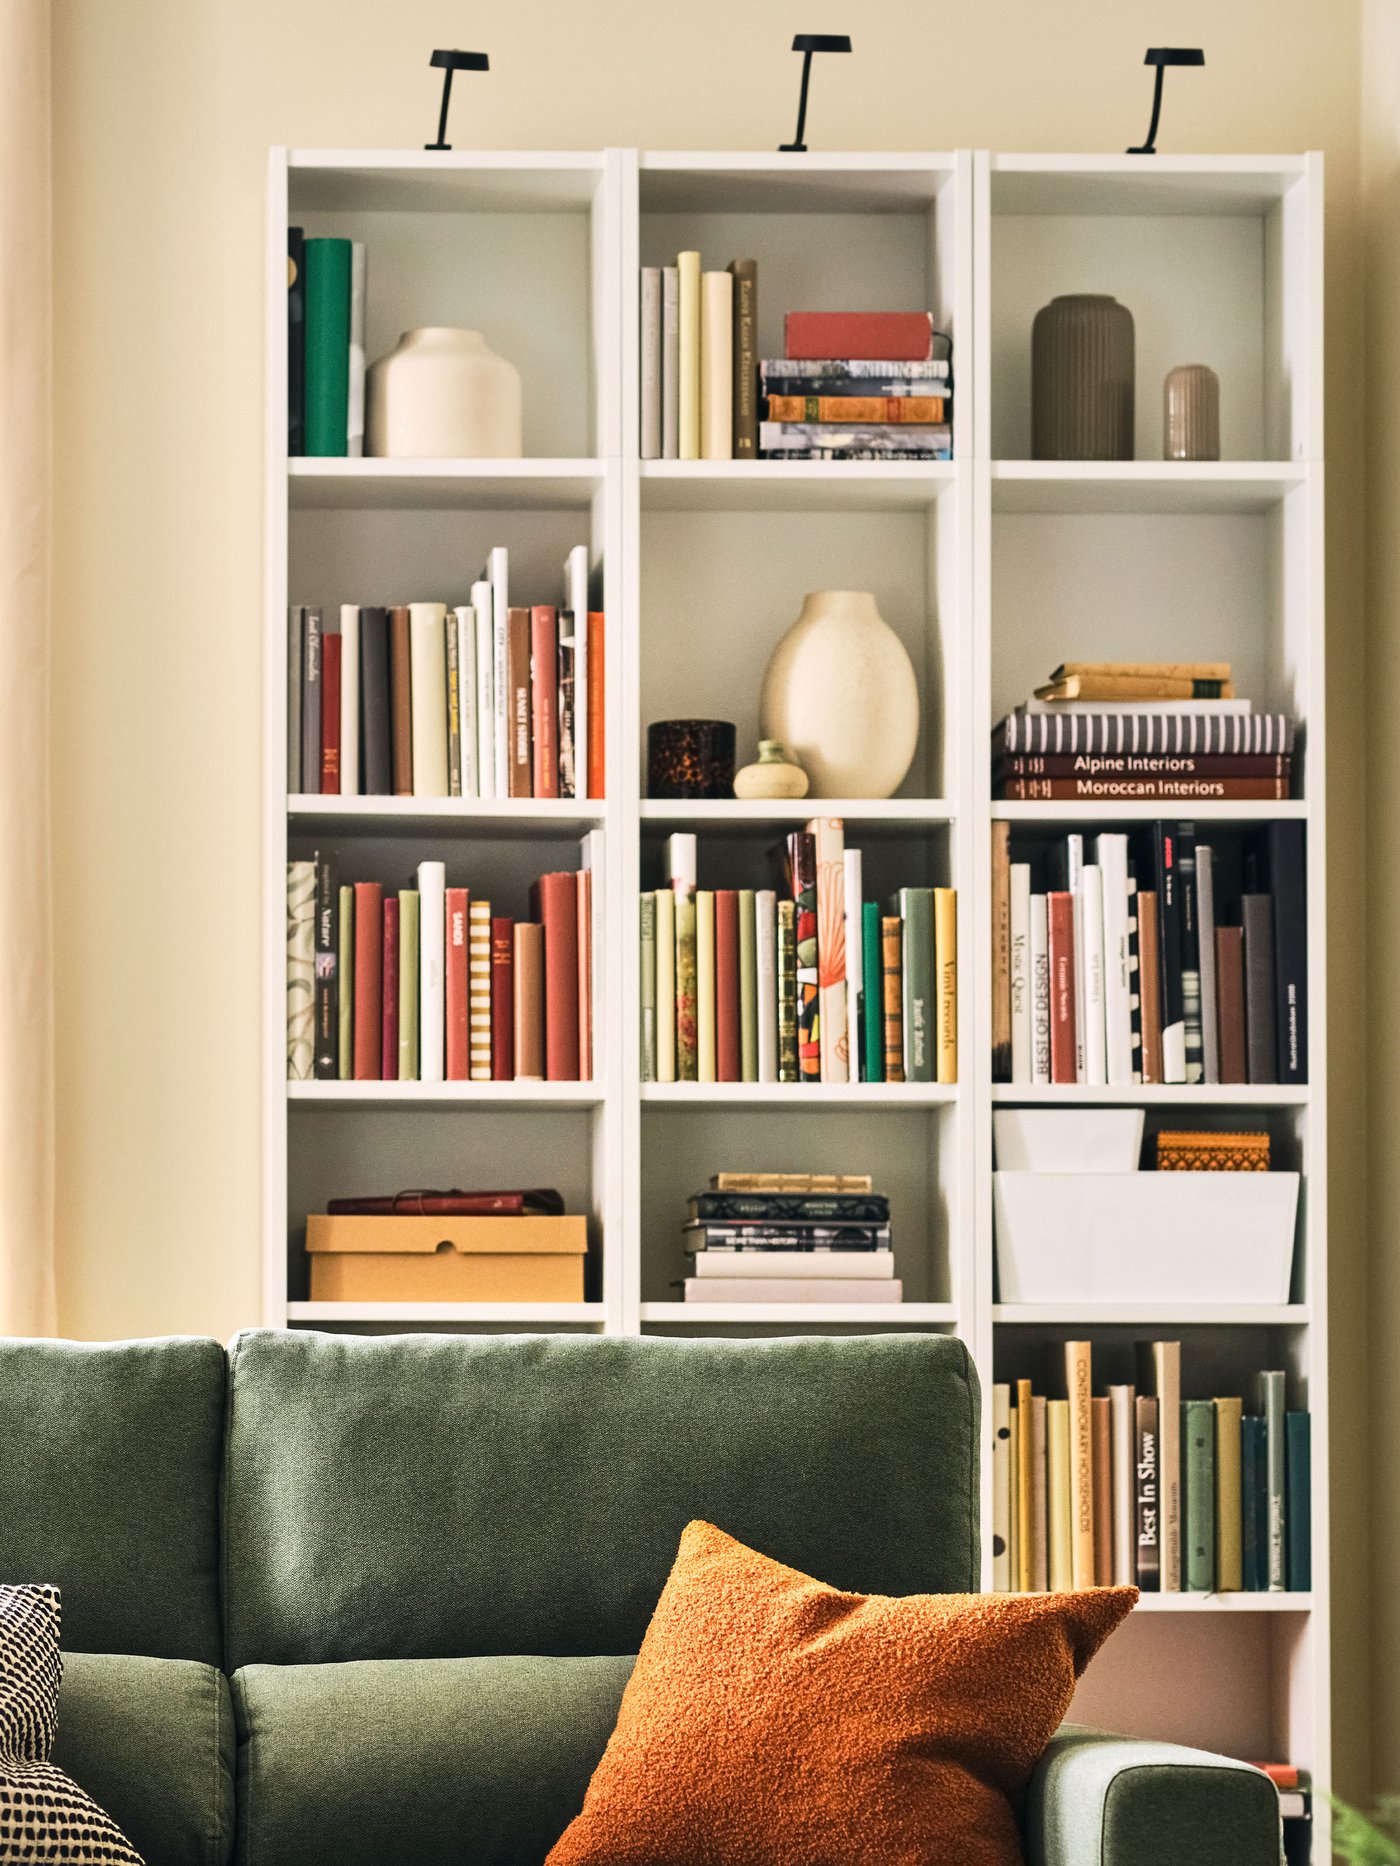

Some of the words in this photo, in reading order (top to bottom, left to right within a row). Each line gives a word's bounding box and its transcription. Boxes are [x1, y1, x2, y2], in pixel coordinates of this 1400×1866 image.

[1074, 756, 1125, 775] Alpine
[1127, 756, 1195, 771] Interiors
[1077, 780, 1156, 795] Moroccan
[1158, 780, 1224, 796] Interiors
[321, 907, 332, 947] Nature
[1035, 953, 1047, 1010] DESIGN
[1036, 1018, 1047, 1035] OF
[1036, 1040, 1048, 1075] BEST
[1077, 1359, 1089, 1454] CONTEMPORARY
[1137, 1432, 1156, 1480] Show
[1079, 1458, 1091, 1533] HOUSEHOLDS
[1138, 1484, 1156, 1503] In
[1138, 1507, 1157, 1546] Best
